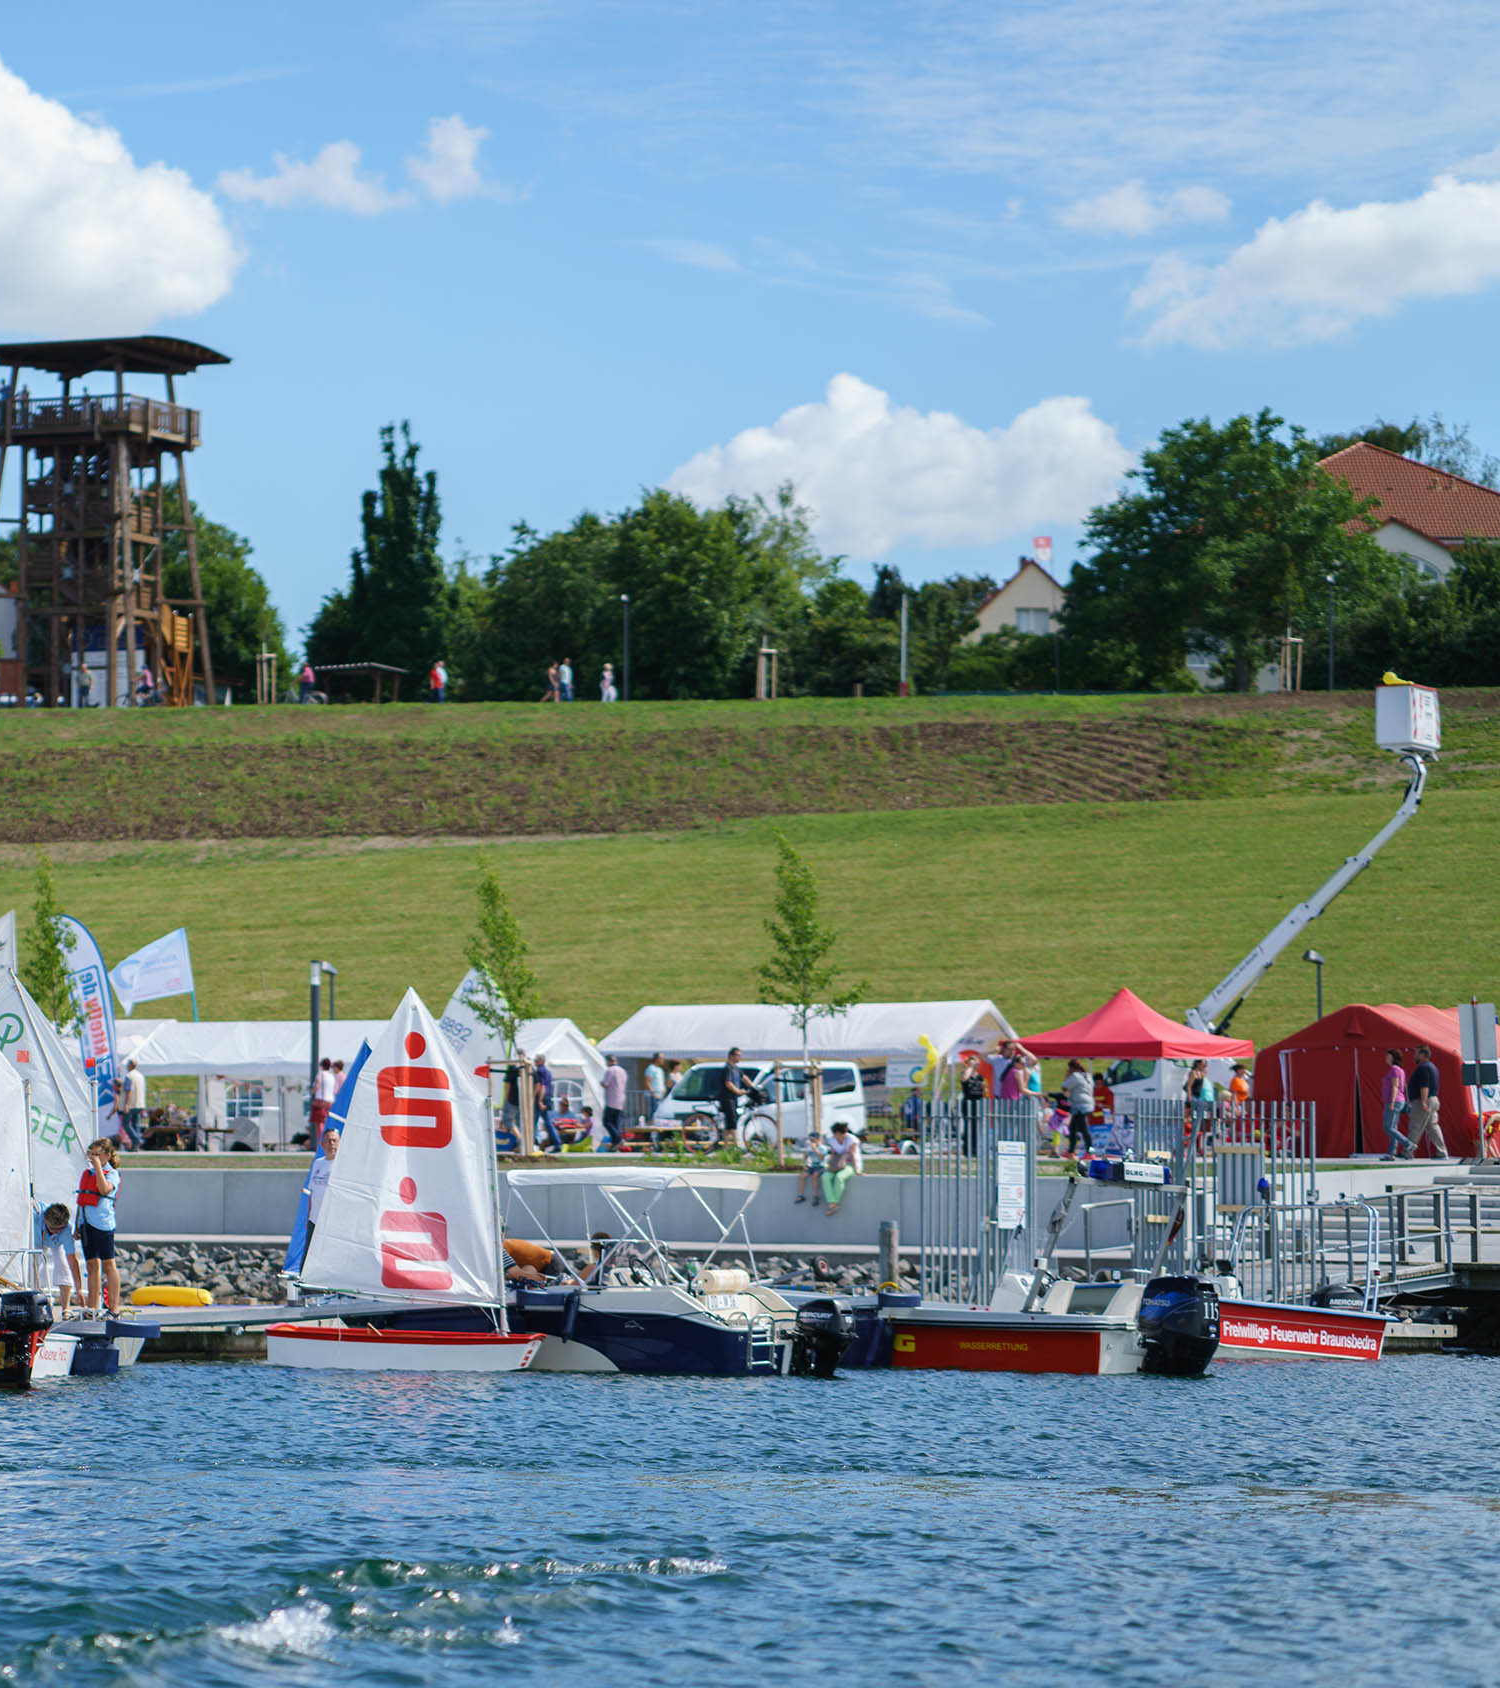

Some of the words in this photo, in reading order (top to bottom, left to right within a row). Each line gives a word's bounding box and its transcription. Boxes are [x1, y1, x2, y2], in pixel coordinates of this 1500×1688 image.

[1203, 1302, 1219, 1322] 115
[1223, 1320, 1269, 1344] Freiwillige
[1271, 1325, 1319, 1345] Feuerwehr
[1320, 1329, 1377, 1350] Braunsbedra
[959, 1341, 1029, 1352] WASSERRETTUNG
